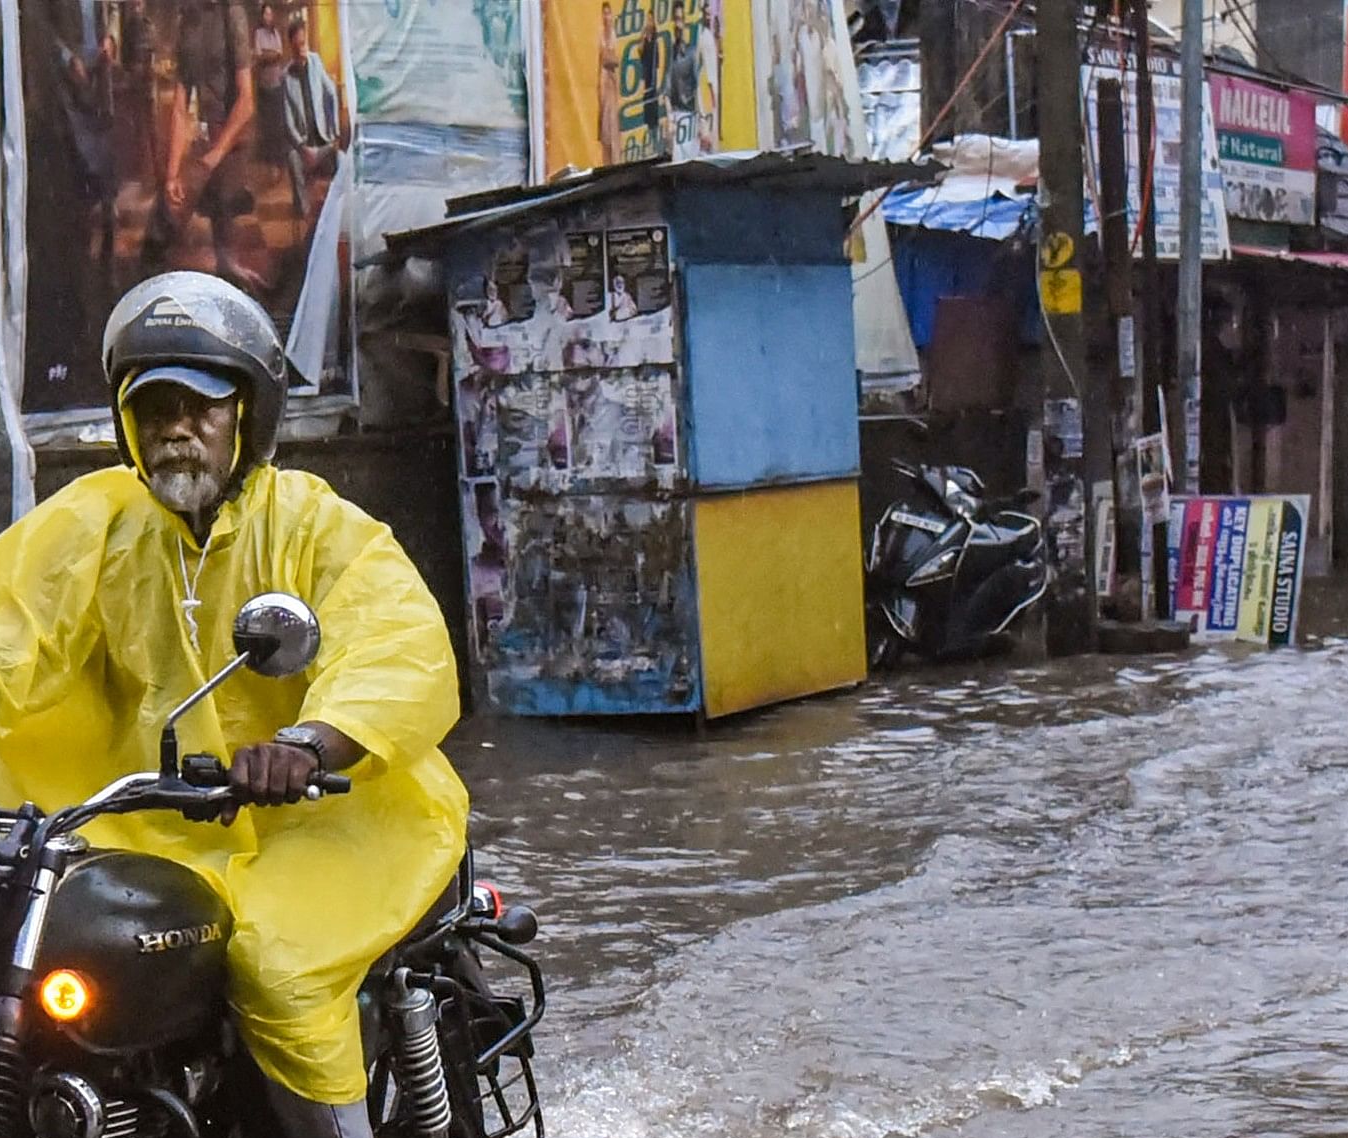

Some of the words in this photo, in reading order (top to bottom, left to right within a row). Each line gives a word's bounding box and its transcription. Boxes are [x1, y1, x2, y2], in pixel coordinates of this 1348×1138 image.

[1231, 137, 1283, 163] Natural
[1232, 506, 1248, 533] KEY
[1276, 531, 1298, 575] SAINA
[1222, 535, 1244, 627] DUPLICATING
[1272, 576, 1293, 634] STUDIO
[135, 922, 222, 953] HONDA
